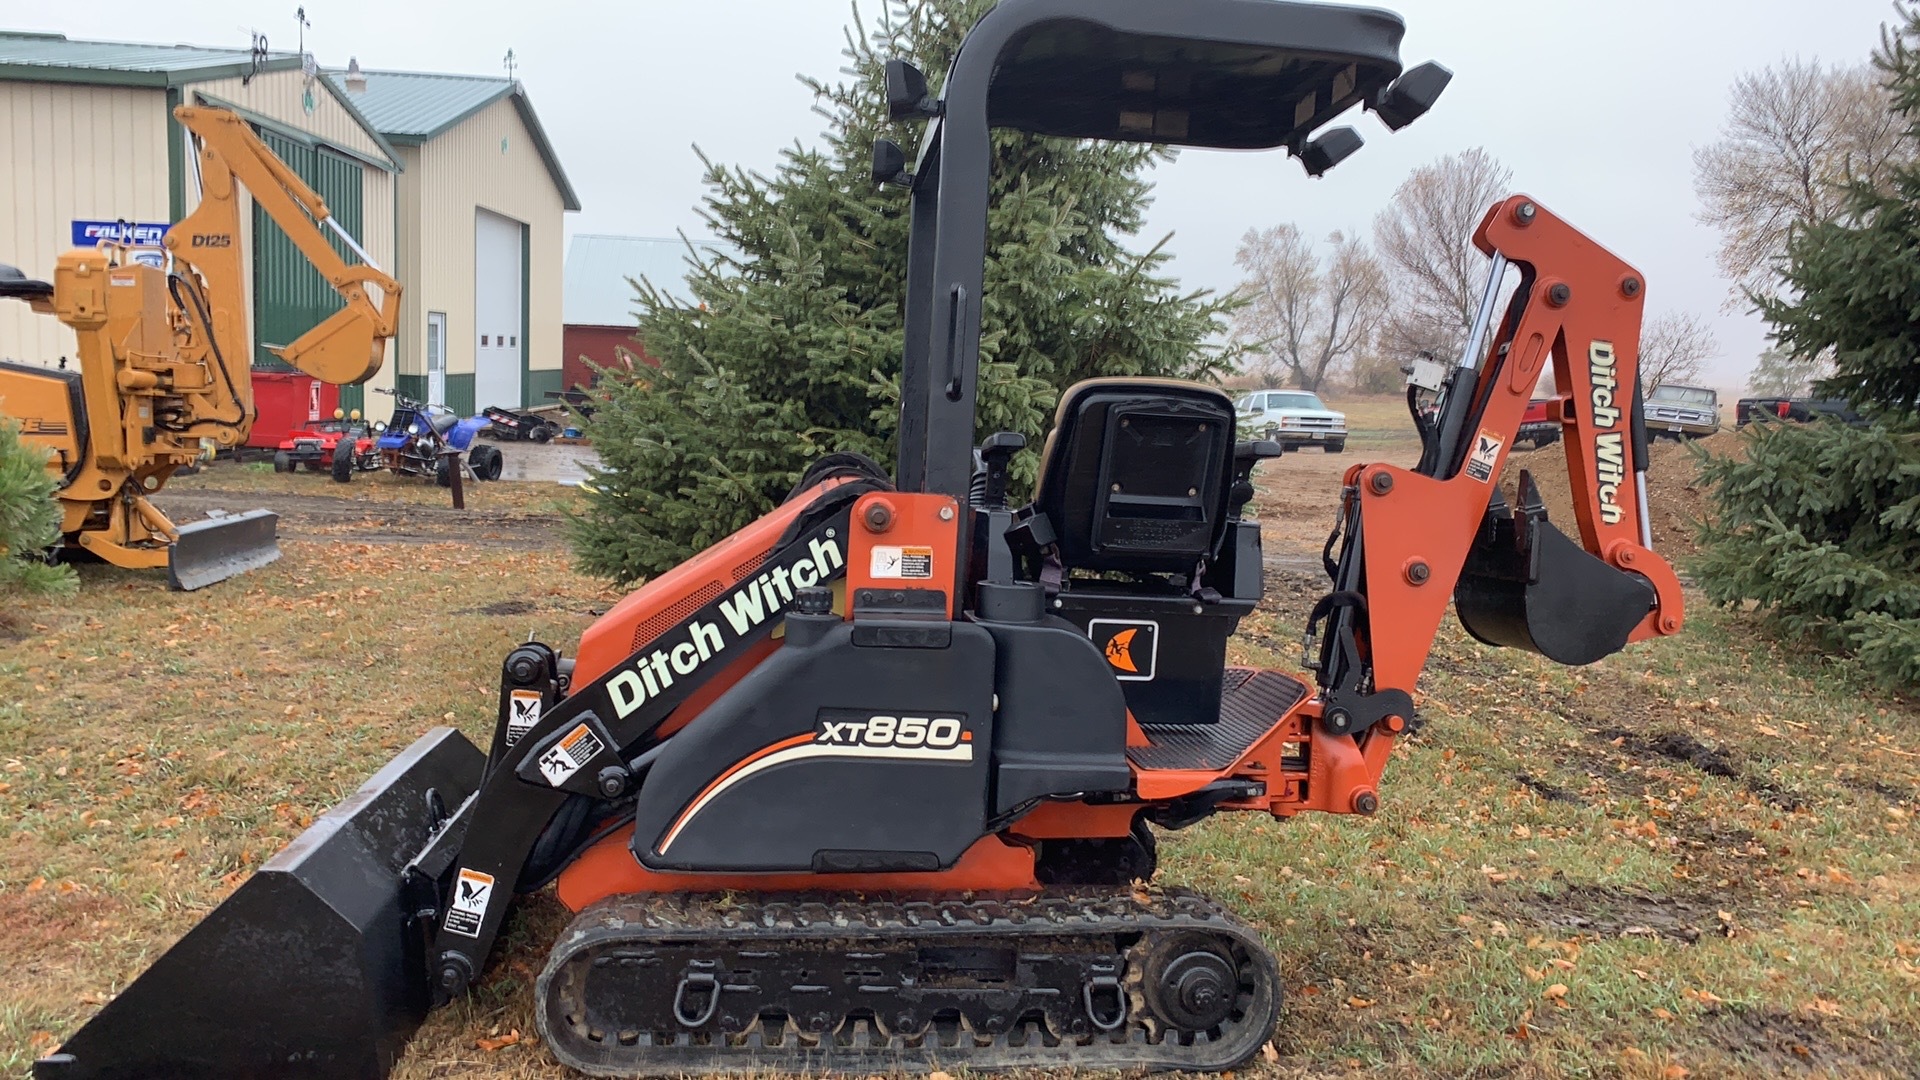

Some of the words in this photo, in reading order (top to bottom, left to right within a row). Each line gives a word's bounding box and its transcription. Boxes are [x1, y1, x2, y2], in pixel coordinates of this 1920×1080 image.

[85, 225, 162, 240] FALKEN
[192, 234, 230, 248] D125
[1590, 341, 1620, 428] Ditch
[1596, 433, 1624, 524] Witch
[606, 620, 726, 720] Ditch
[719, 537, 844, 636] Witch
[818, 716, 961, 746] XT850
